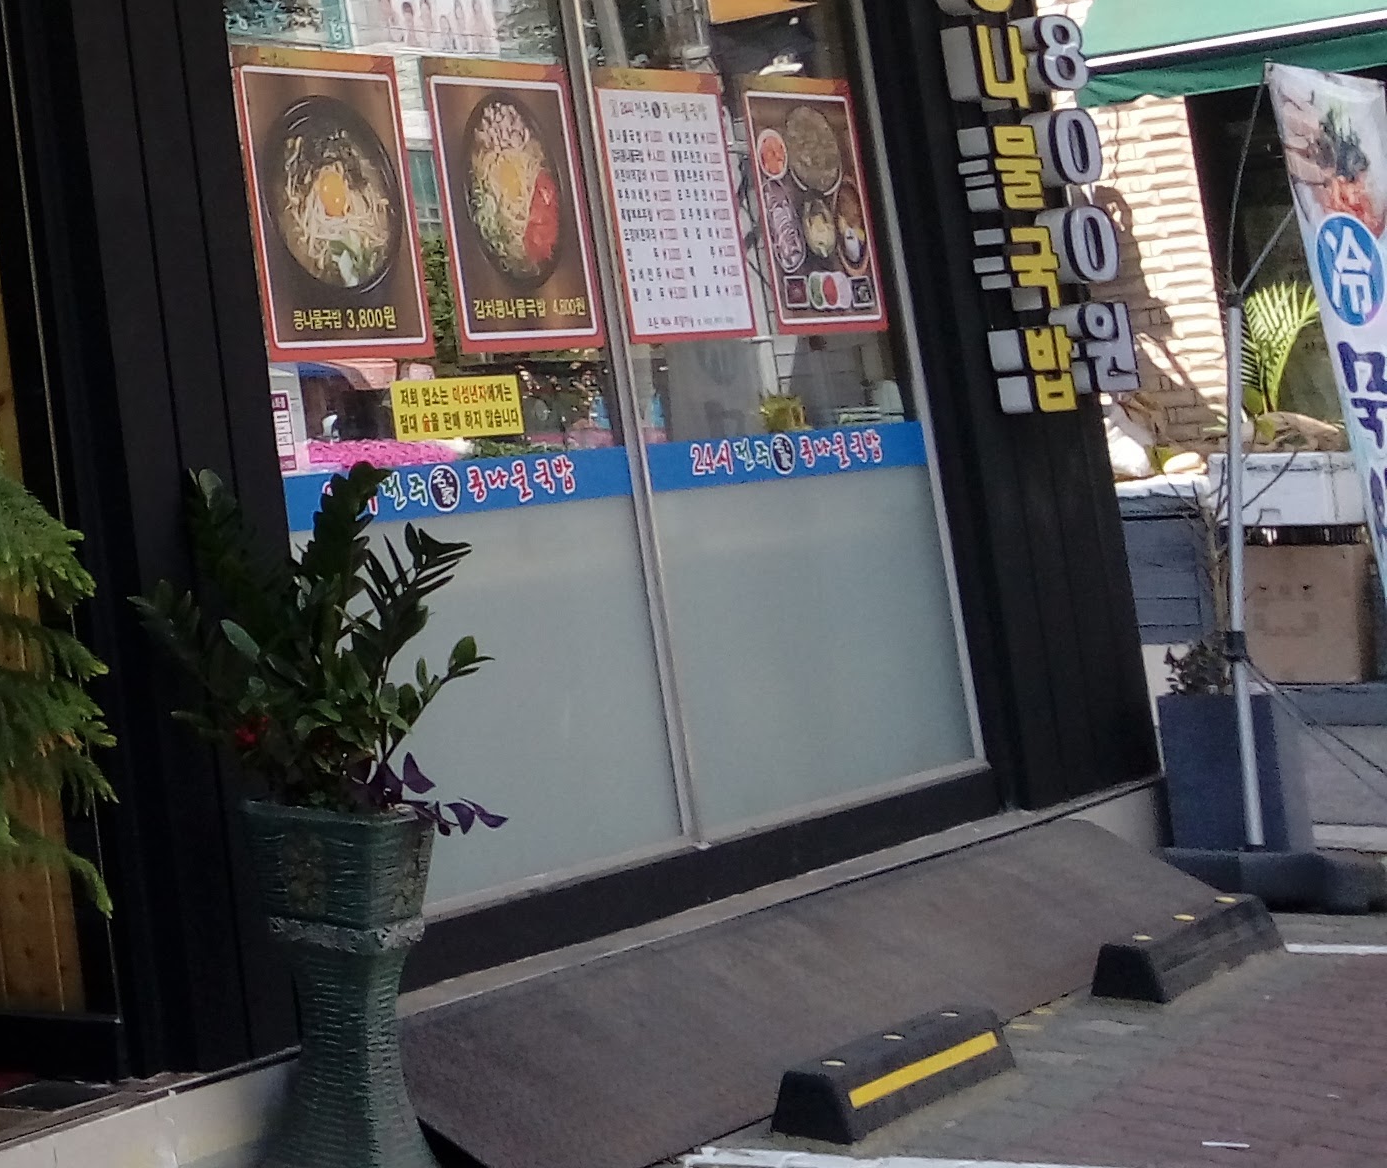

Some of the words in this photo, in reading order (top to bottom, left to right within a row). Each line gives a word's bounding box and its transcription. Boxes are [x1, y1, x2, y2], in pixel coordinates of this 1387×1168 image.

[293, 309, 342, 331] 콩나물국밥
[347, 306, 397, 331] 3,800원
[400, 388, 419, 408] 저희
[691, 440, 733, 475] 24시
[799, 429, 883, 469] 콩나물국밥
[466, 454, 576, 502] 콩나물국밥
